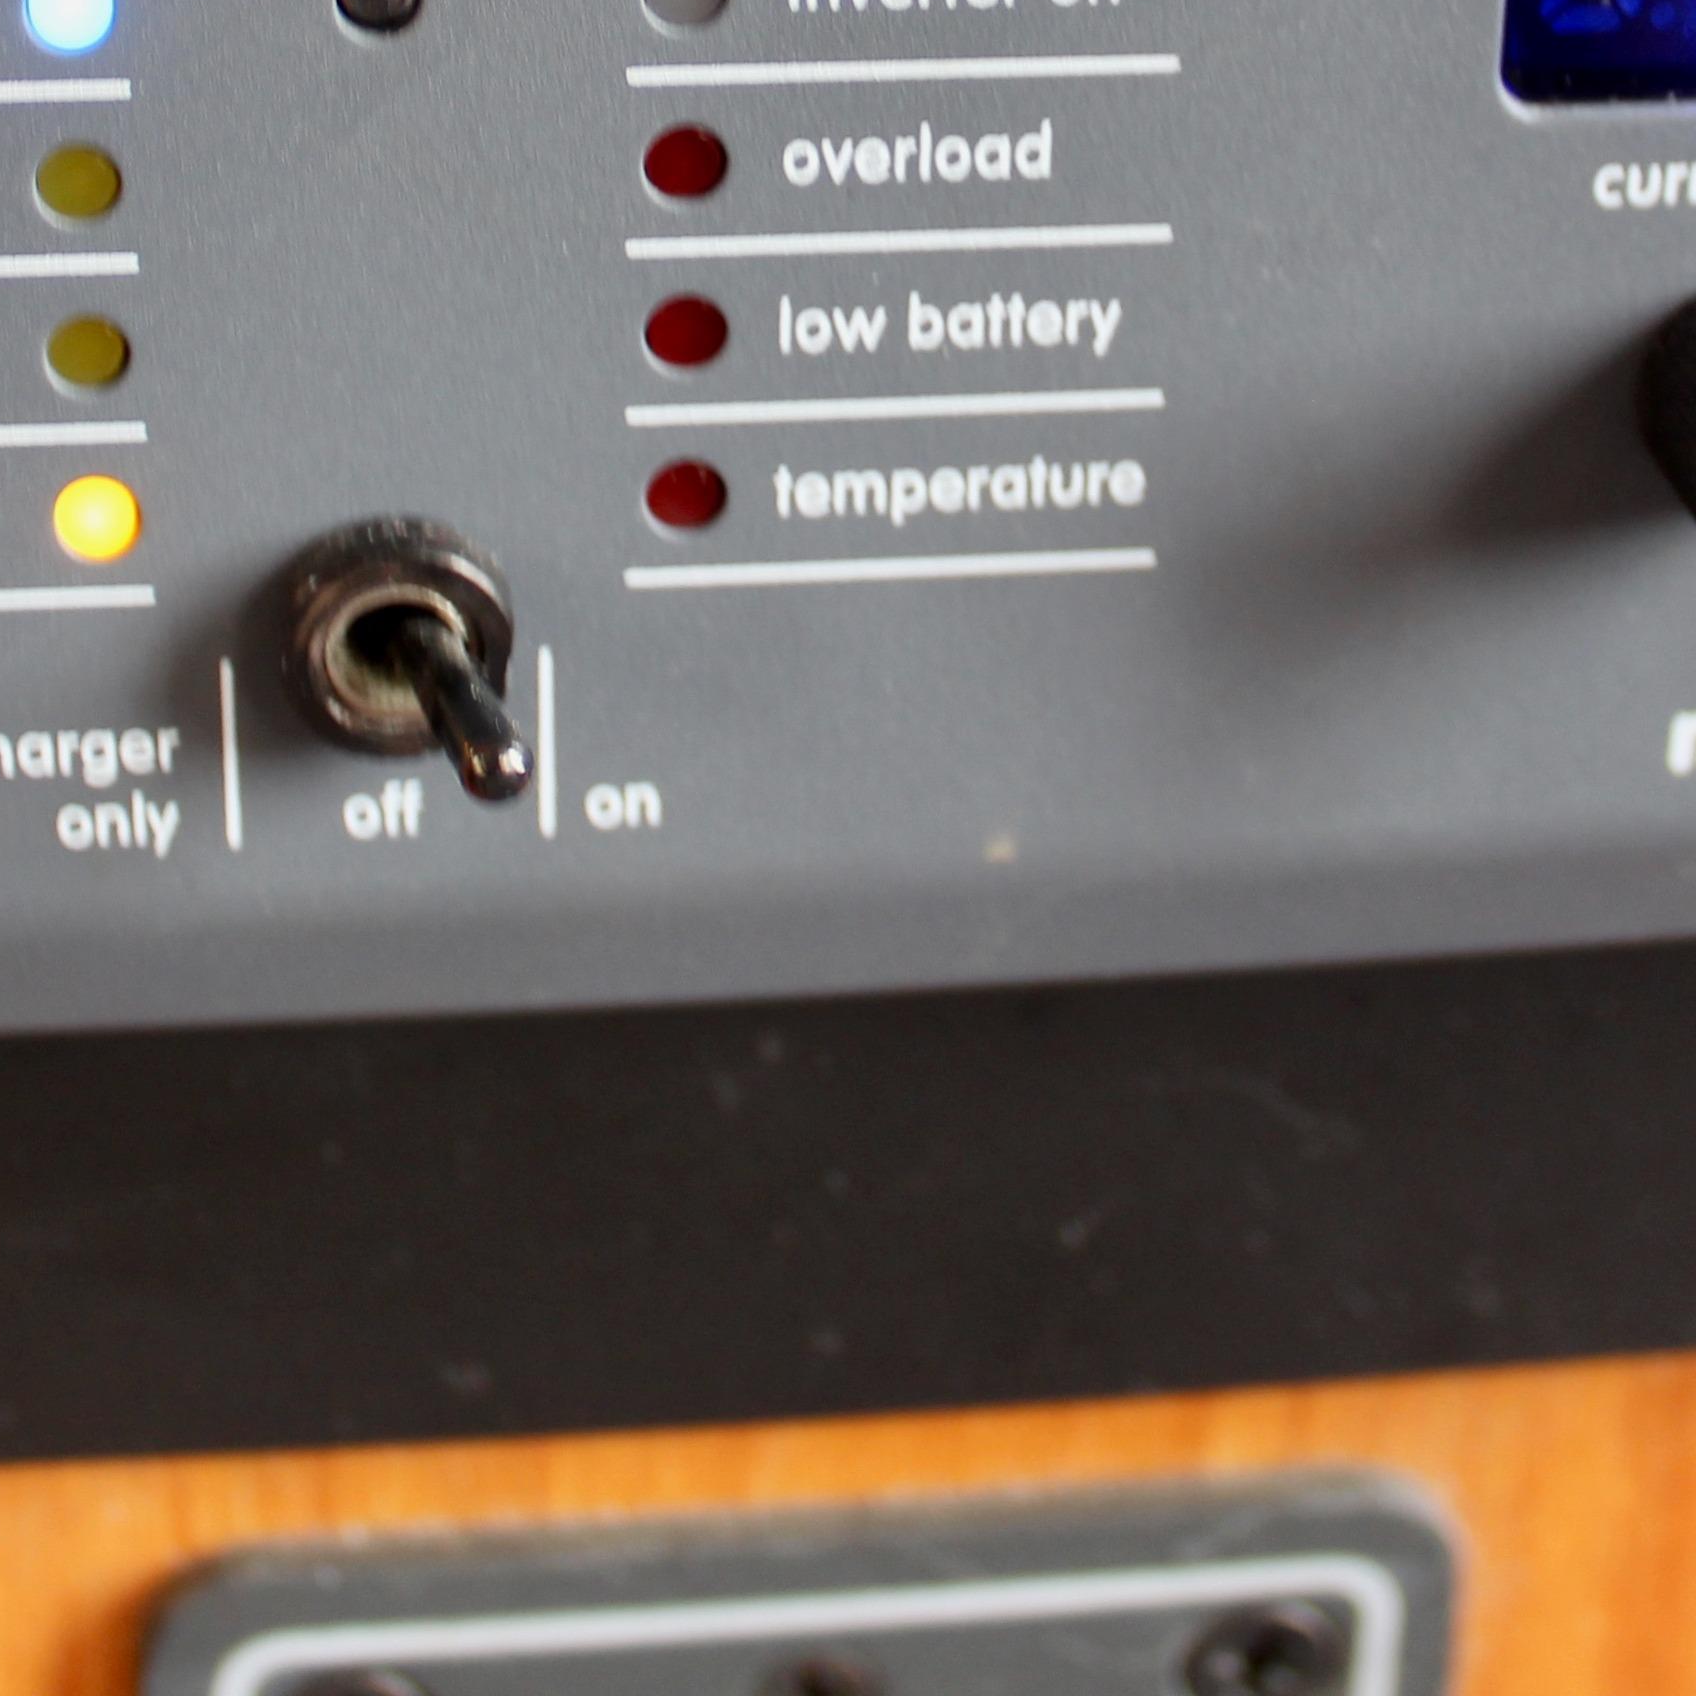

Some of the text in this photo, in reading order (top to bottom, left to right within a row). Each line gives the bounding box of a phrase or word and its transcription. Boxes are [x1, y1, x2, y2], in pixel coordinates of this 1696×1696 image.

[783, 117, 1053, 186] overload
[779, 291, 1121, 357] low battery
[774, 454, 1147, 527] temperature
[56, 789, 180, 859] only
[342, 779, 424, 841] off
[584, 780, 662, 830] on
